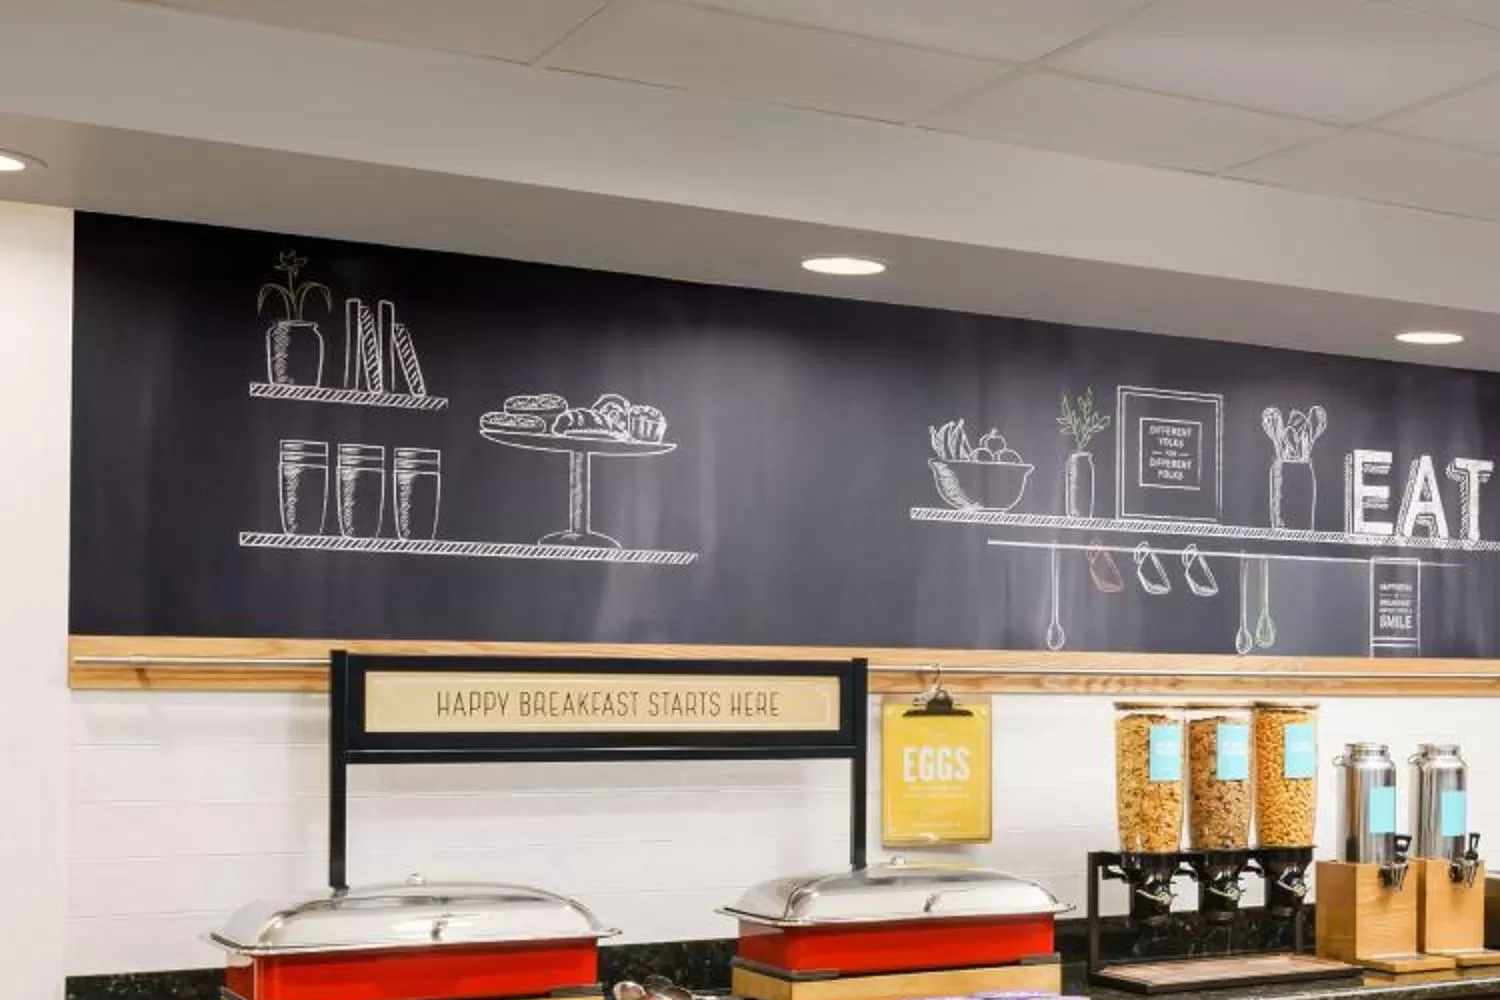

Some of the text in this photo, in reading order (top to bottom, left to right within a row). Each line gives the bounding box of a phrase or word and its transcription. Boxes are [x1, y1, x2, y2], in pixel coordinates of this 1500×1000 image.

[1345, 450, 1495, 541] EAT
[437, 691, 780, 717] HAPPY BREAKFAST STARTS HERE
[902, 746, 971, 783] EGGS
